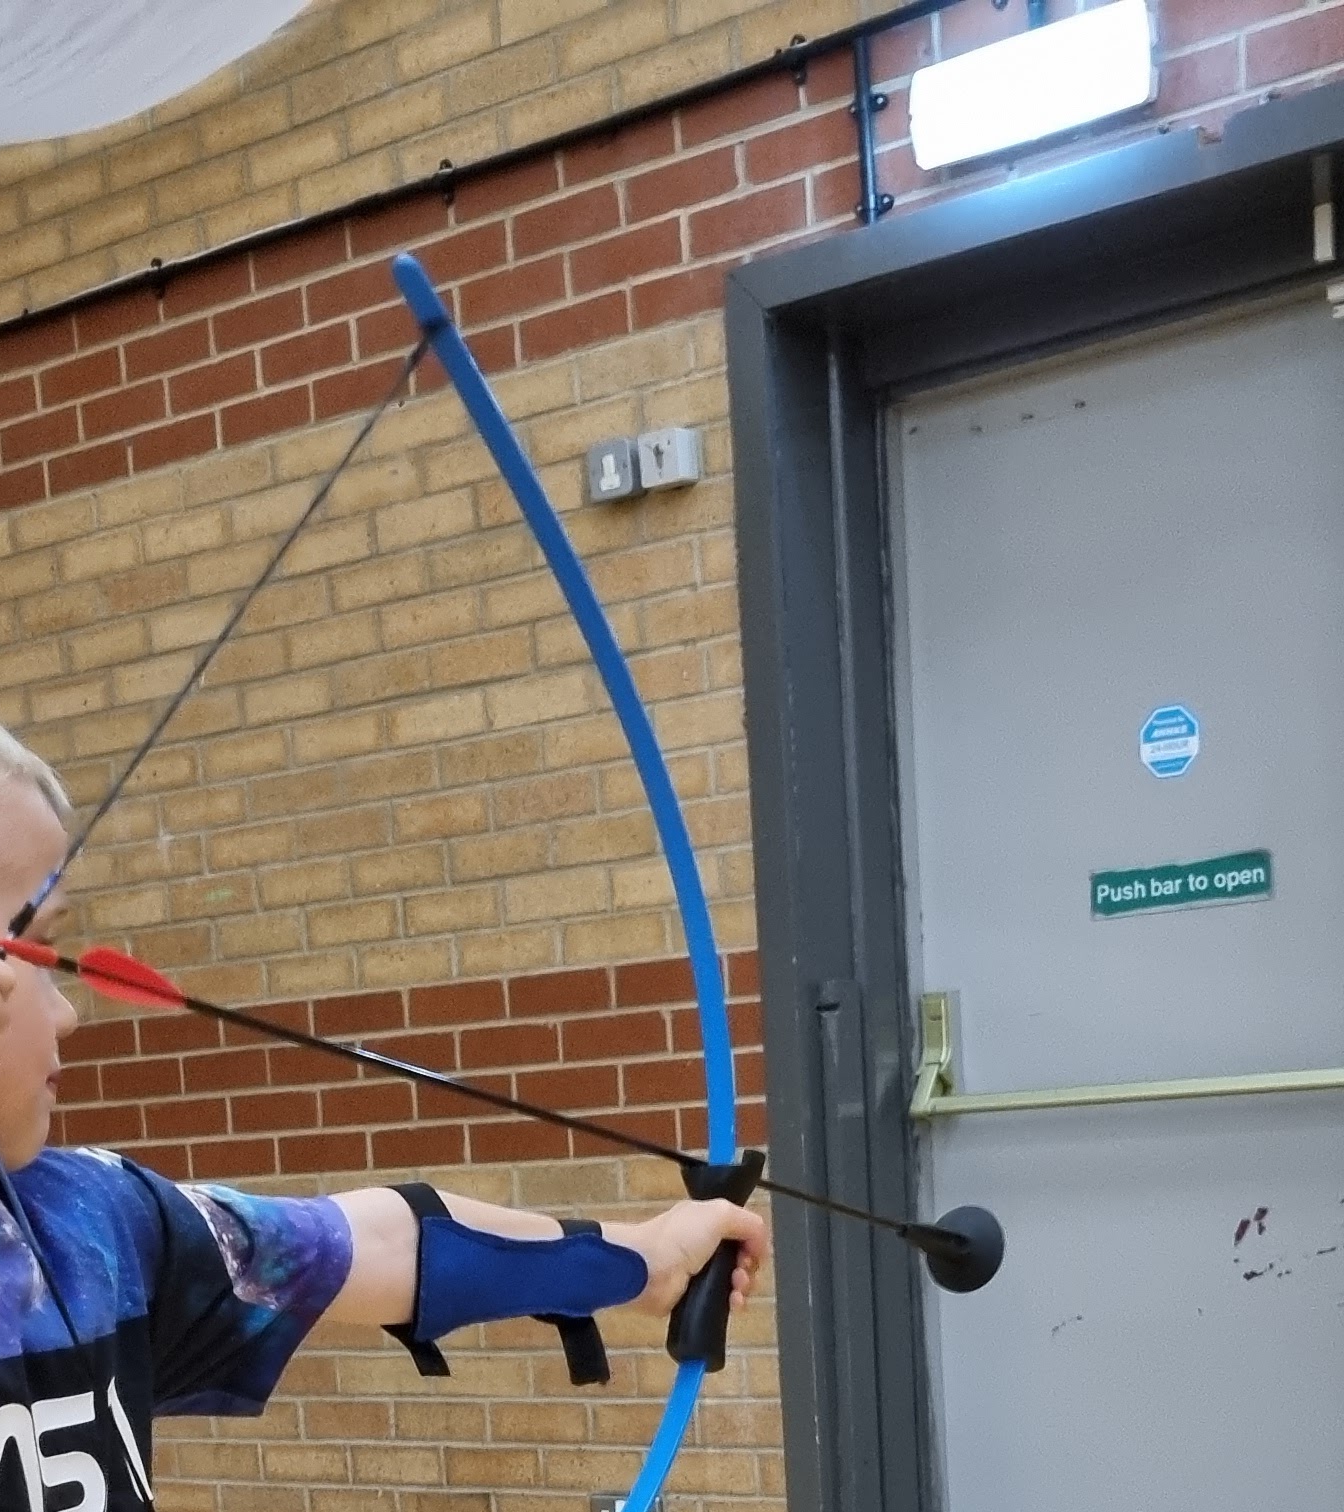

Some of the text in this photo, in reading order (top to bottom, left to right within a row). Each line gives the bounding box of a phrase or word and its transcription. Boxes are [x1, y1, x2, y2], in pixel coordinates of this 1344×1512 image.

[1096, 866, 1265, 904] Push bar to open
